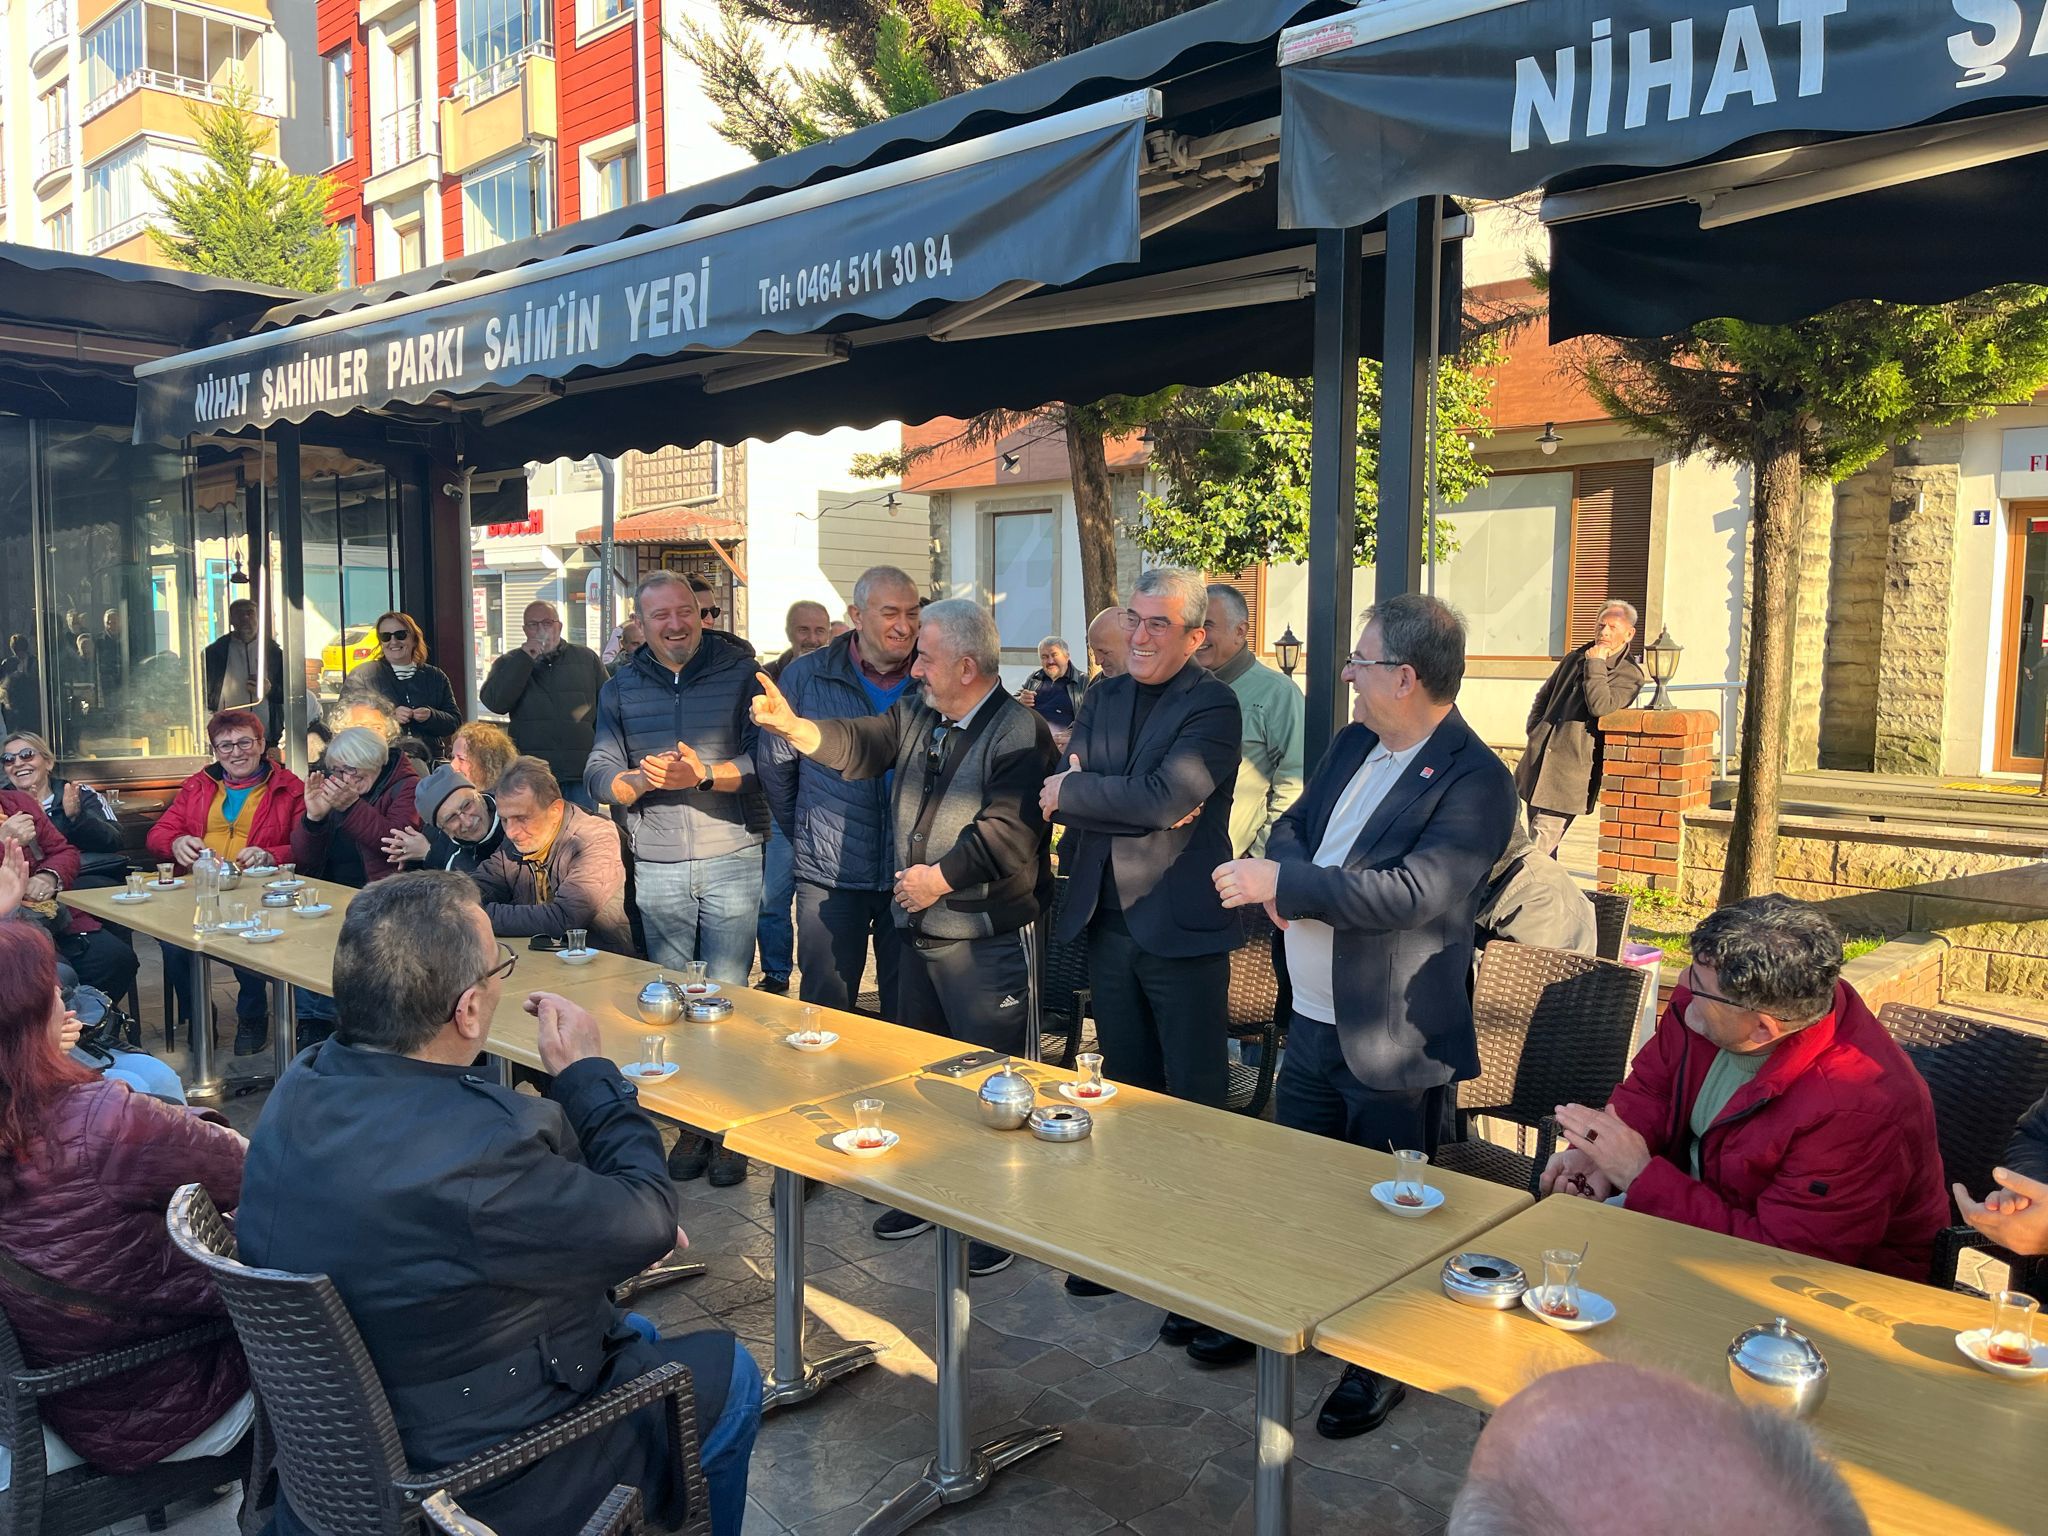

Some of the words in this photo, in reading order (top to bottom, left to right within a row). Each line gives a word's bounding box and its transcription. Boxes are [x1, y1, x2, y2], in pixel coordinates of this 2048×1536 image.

[1511, 0, 1847, 152] NİHAT
[1947, 0, 2048, 88] Ş
[194, 372, 250, 422] NİHAT
[261, 352, 368, 418] ŞAHİNLER
[387, 326, 464, 390] PARKI
[625, 256, 709, 342] YERİ
[759, 274, 790, 314] Tel:
[797, 260, 841, 306] 0464
[848, 249, 883, 295] 511
[891, 242, 916, 286] 30
[924, 234, 953, 279] 84
